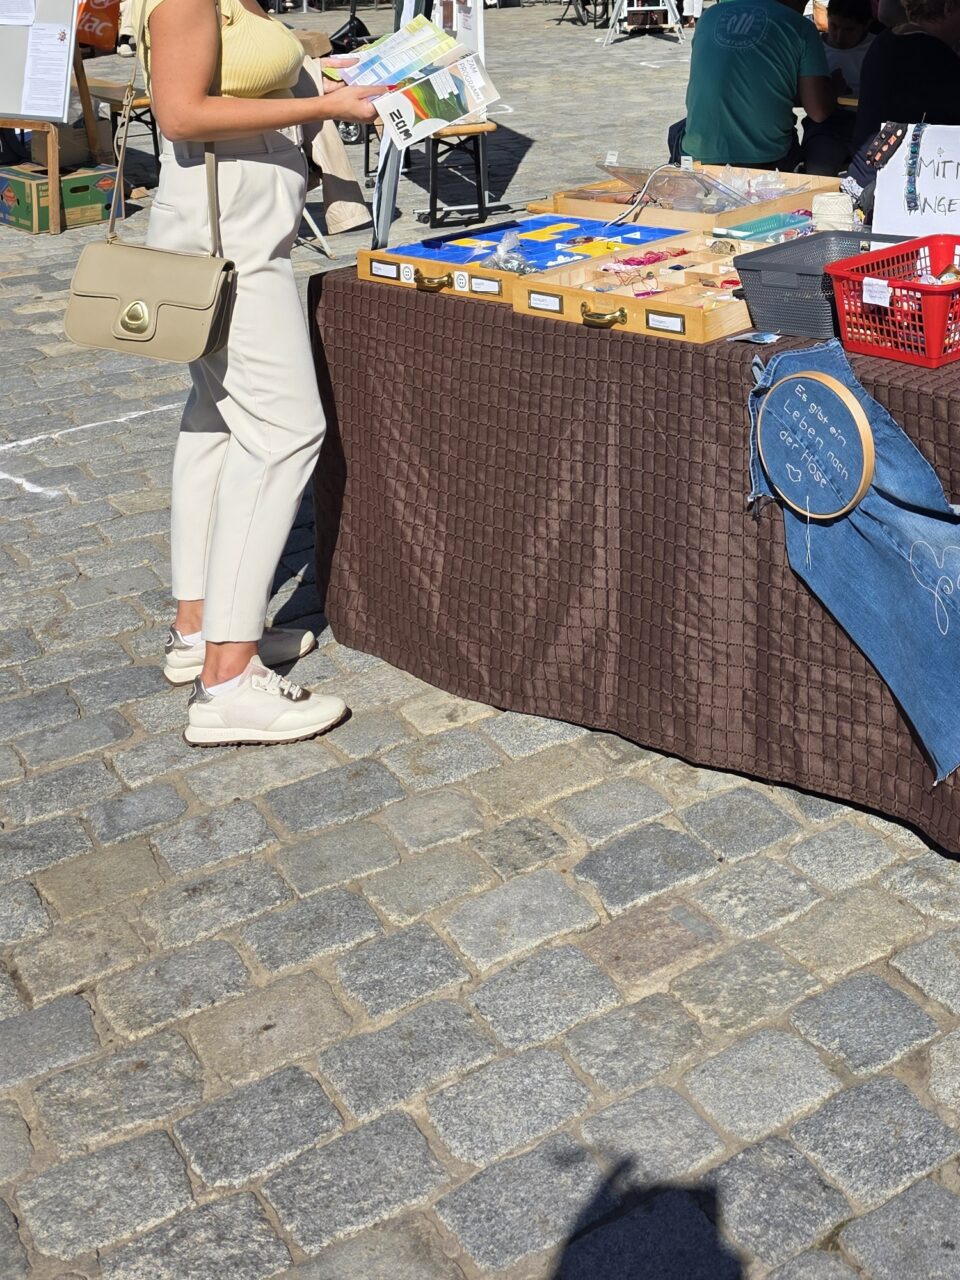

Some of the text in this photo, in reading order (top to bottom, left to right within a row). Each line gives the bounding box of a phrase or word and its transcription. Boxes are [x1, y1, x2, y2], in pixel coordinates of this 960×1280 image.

[783, 399, 849, 480] Leben nach
[794, 384, 847, 447] Es gibt ein
[779, 430, 827, 488] der Hose
